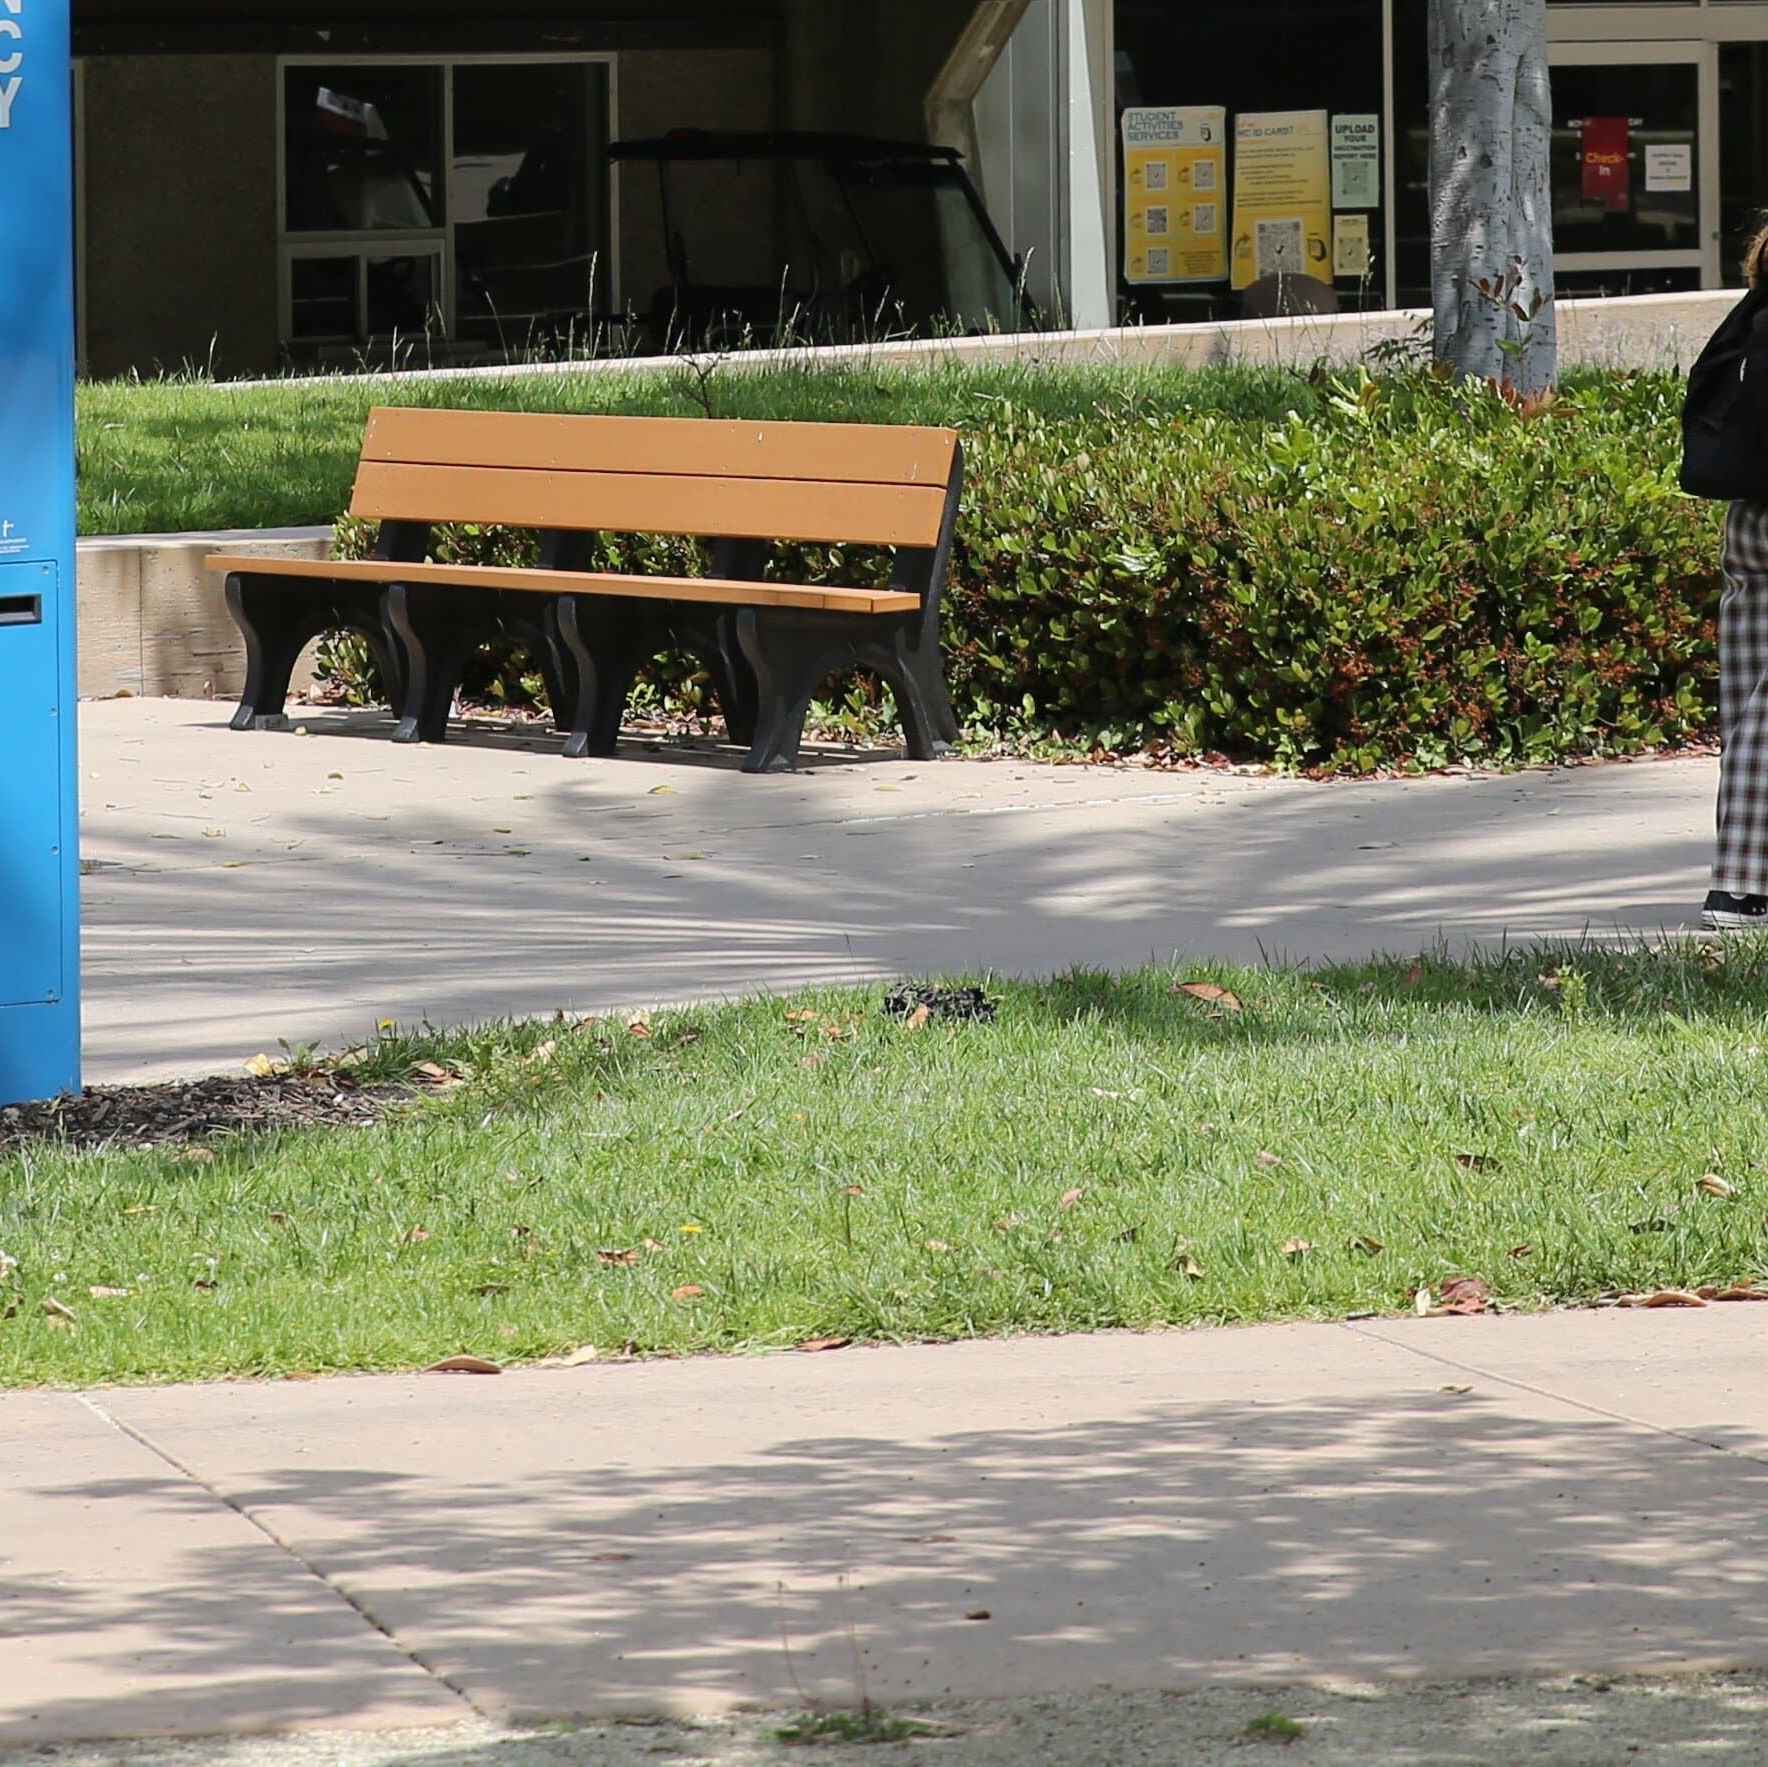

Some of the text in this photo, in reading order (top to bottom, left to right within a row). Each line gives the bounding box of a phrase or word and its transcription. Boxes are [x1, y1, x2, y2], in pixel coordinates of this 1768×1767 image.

[1127, 111, 1176, 122] STUDENT
[1127, 120, 1184, 131] ACTIVITIES
[1335, 124, 1375, 134] UPLOAD
[1127, 130, 1179, 141] SERVICES
[1344, 134, 1366, 142] YOUR
